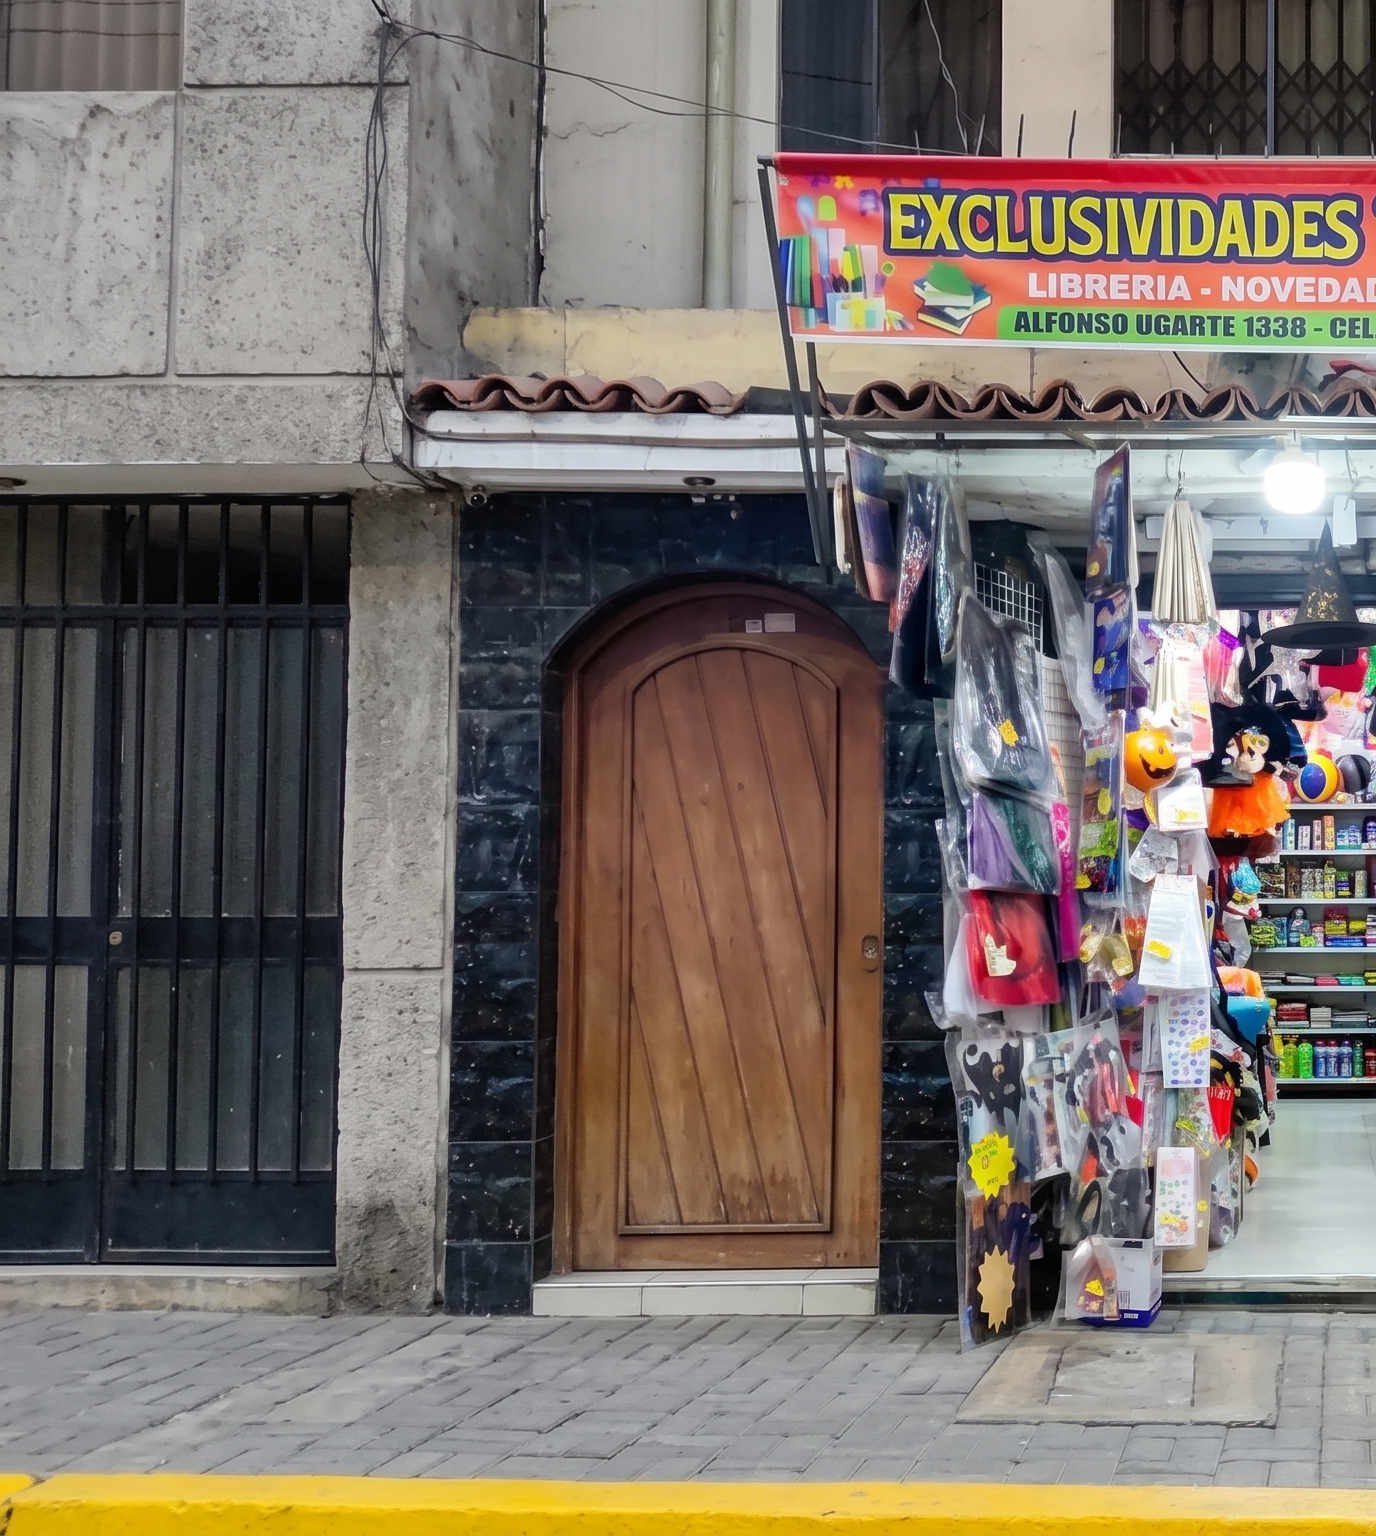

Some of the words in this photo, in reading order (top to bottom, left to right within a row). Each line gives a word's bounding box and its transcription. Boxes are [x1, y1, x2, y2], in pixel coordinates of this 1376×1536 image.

[885, 193, 1359, 259] EXCLUSIVIDADES
[1028, 272, 1192, 301] LIBRERIA
[1014, 311, 1128, 335] ALFONSO
[1136, 314, 1235, 338] UGARTE
[1242, 316, 1306, 338] 1338
